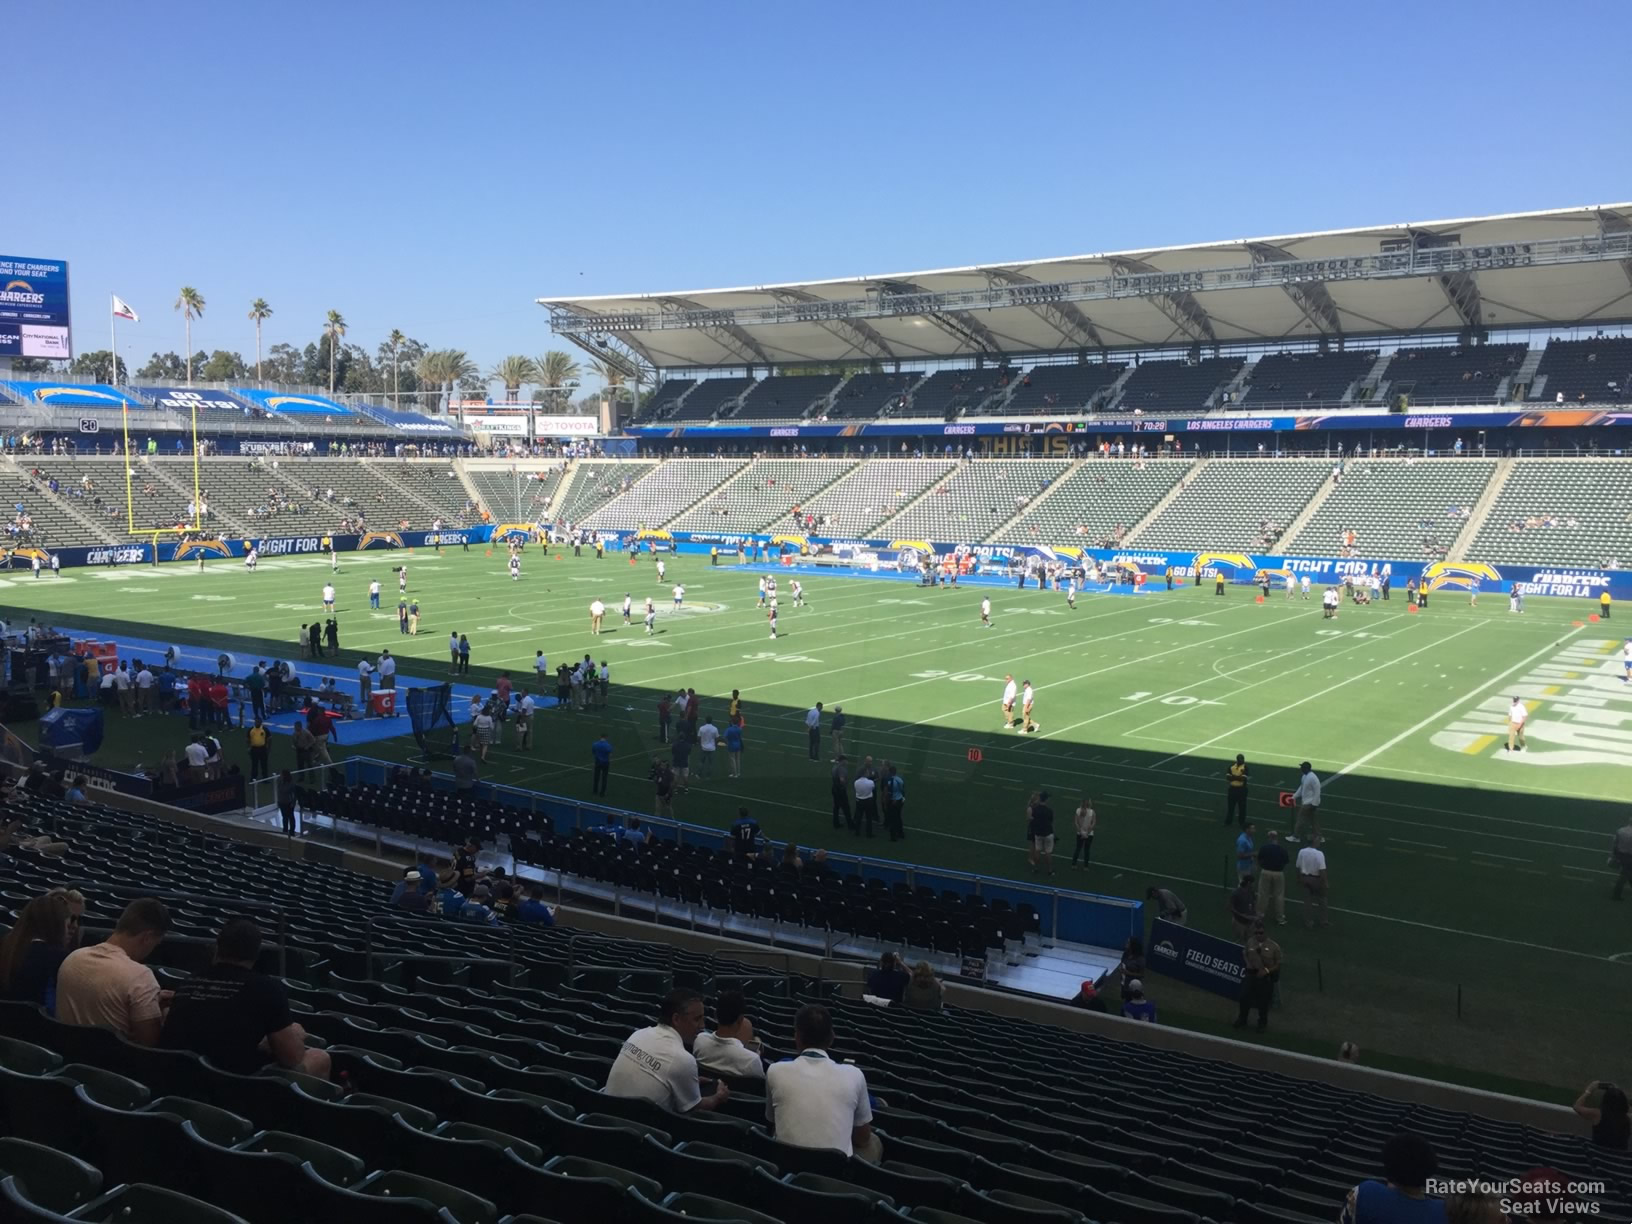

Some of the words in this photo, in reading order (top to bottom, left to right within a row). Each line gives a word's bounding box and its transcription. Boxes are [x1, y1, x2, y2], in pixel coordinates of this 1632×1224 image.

[14, 269, 31, 277] YOUR
[27, 264, 60, 273] CHARGERS
[168, 391, 203, 400] GO
[82, 420, 96, 431] 20
[555, 421, 595, 430] TOYOTA
[1024, 423, 1031, 432] 0
[1066, 423, 1073, 432] 0
[1144, 422, 1165, 430] 70:29
[1186, 420, 1201, 430] LOS
[1201, 420, 1233, 430] ANGELES
[1233, 419, 1273, 429] CHARGERS
[1404, 417, 1453, 428] CHARGERS
[770, 428, 800, 437] CHARGERS
[944, 425, 976, 435] CHARGERS
[1044, 436, 1069, 454] IS
[424, 533, 462, 545] CHRGERS
[295, 538, 318, 552] FOR
[86, 548, 144, 564] CHAGERS
[1187, 567, 1218, 577] BLTS!
[1282, 559, 1333, 573] FIGHT
[1334, 561, 1368, 575] FOR
[1550, 583, 1572, 596] FOR
[1575, 585, 1590, 597] LA
[382, 696, 391, 708] G
[741, 828, 751, 840] 17
[1153, 944, 1179, 958] CHARGERS
[1186, 948, 1211, 966] FIELD
[1211, 957, 1240, 976] SEATS
